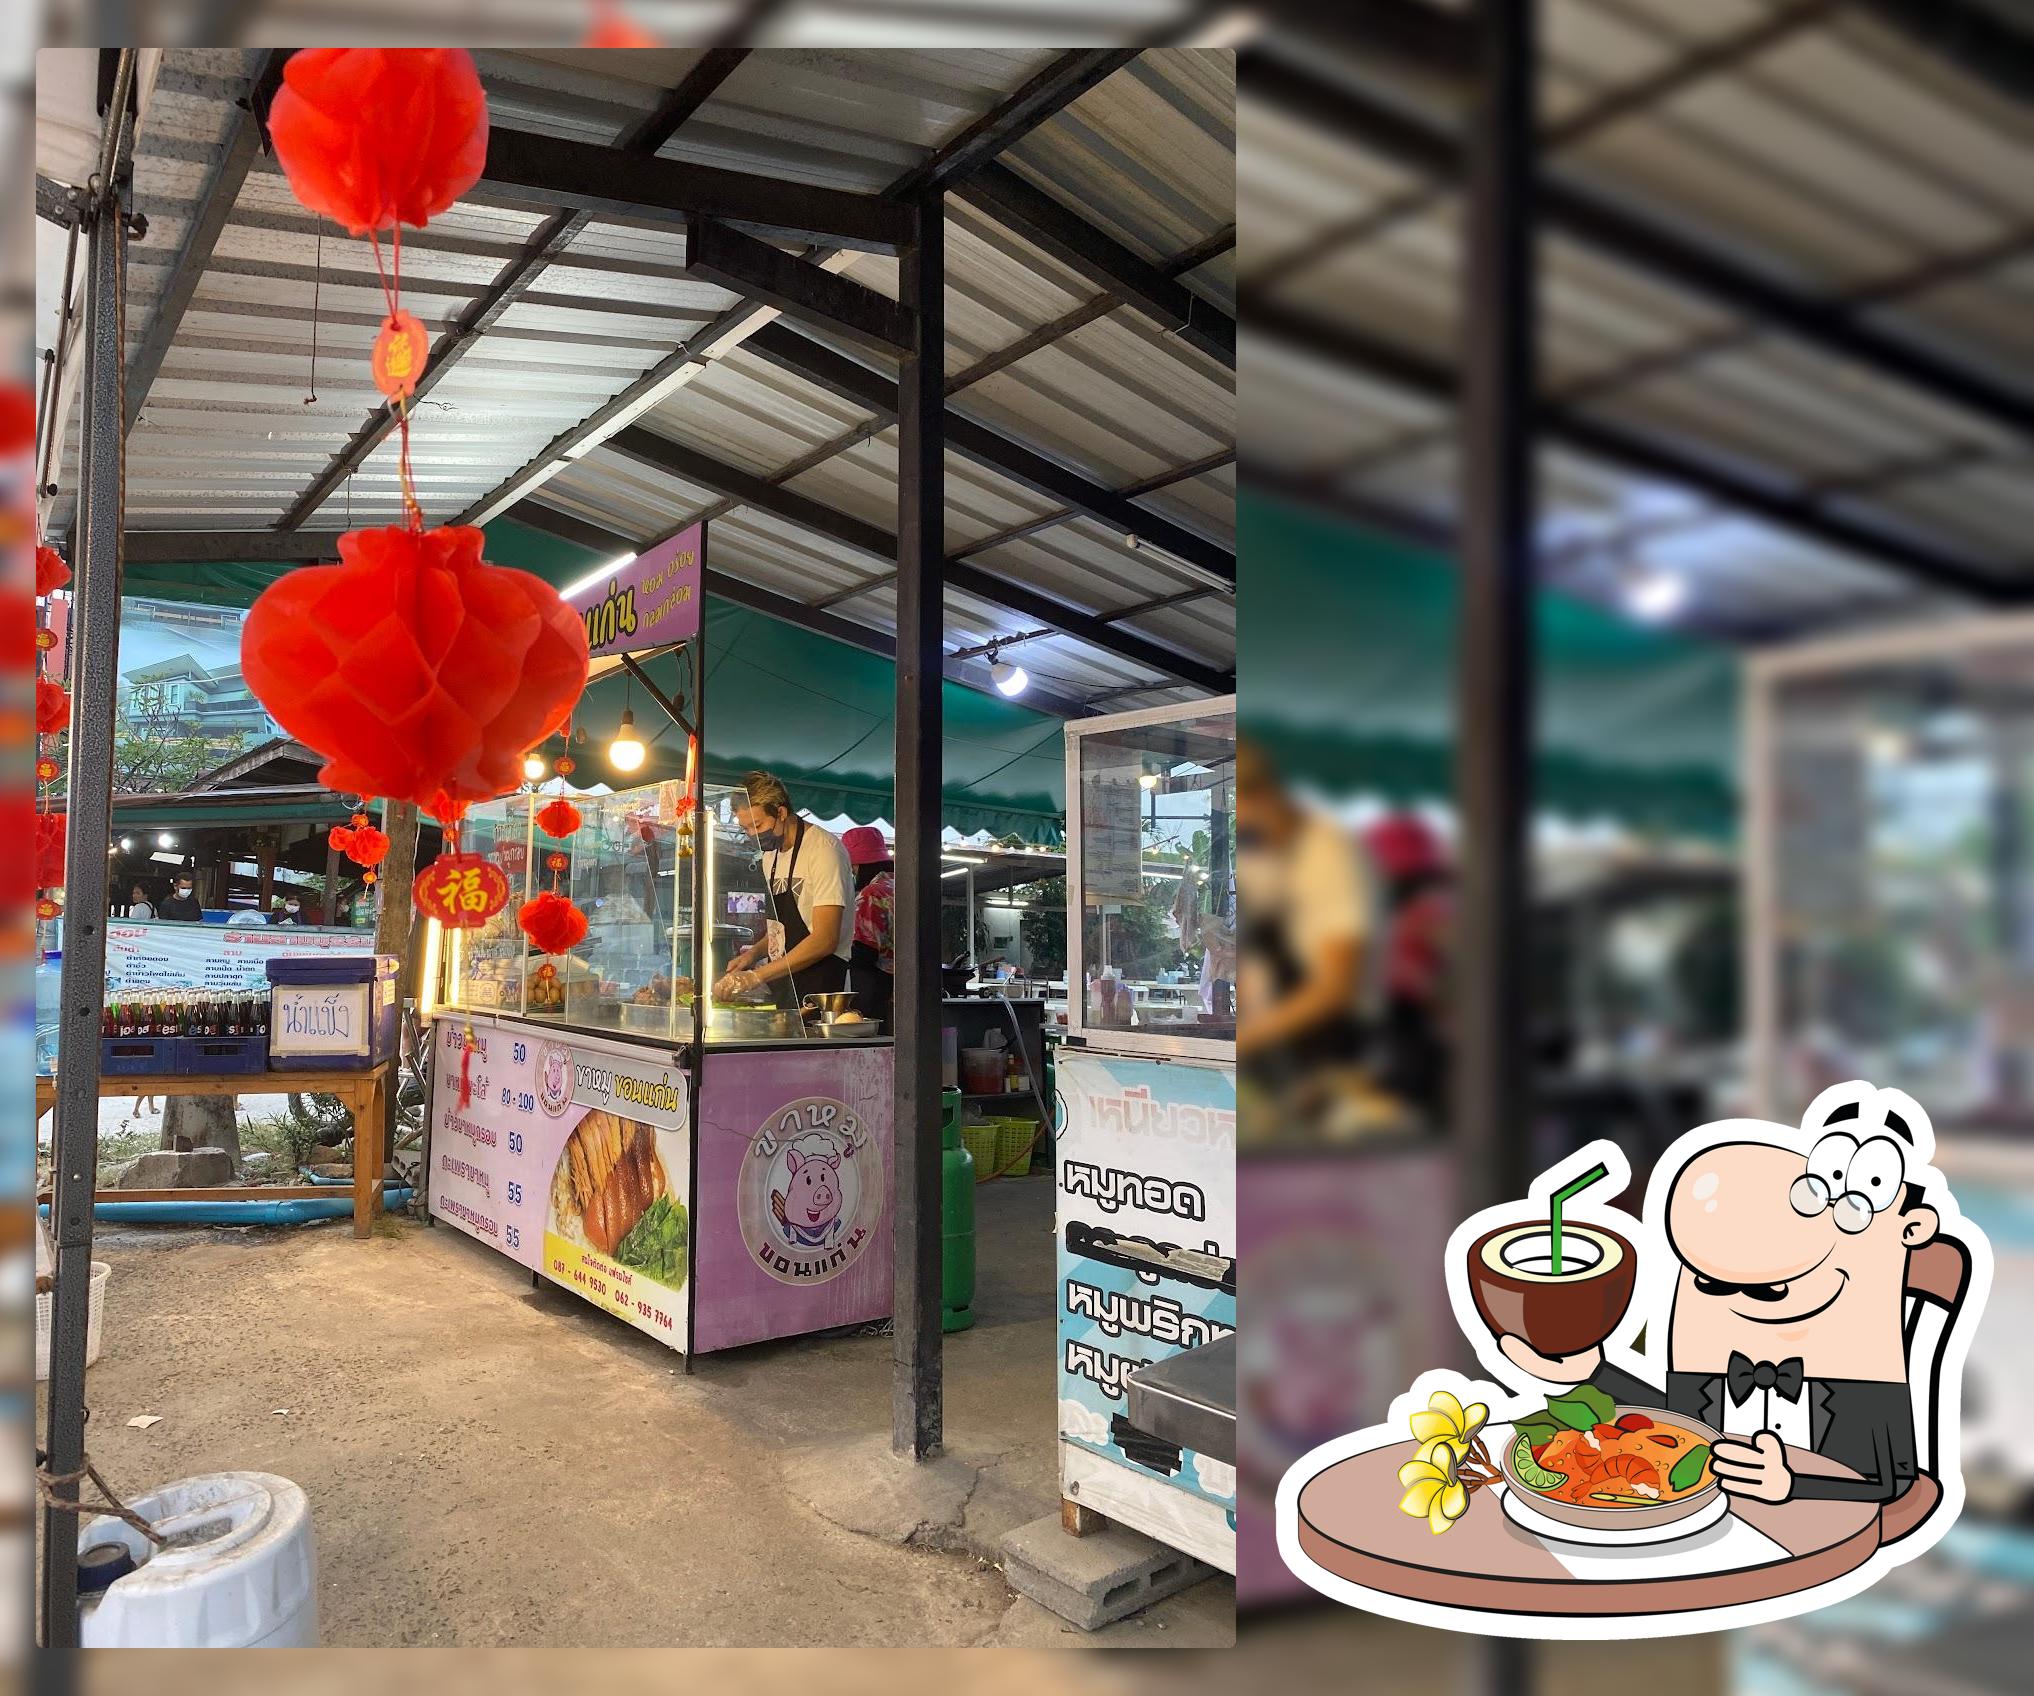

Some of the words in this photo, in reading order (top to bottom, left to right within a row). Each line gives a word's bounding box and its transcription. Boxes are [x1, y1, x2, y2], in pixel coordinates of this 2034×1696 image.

[583, 576, 639, 650] แก่น
[437, 867, 488, 915] 福
[282, 992, 351, 1038] น้ำแข็ง
[513, 1041, 527, 1064] 50
[518, 1092, 535, 1114] 100
[575, 1064, 613, 1106] ขาหมู
[614, 1072, 679, 1113] ขอนแก่น
[508, 1131, 523, 1155] 50
[755, 1104, 868, 1160] ขาหมู
[507, 1180, 522, 1206] 55
[1064, 1159, 1206, 1223] หมูทอด
[506, 1224, 520, 1249] 55
[758, 1226, 867, 1277] ขอนแก่น
[573, 1269, 587, 1286] 644
[589, 1276, 607, 1296] 9530
[614, 1289, 629, 1307] 062
[637, 1301, 652, 1320] 935
[654, 1308, 674, 1331] 7764
